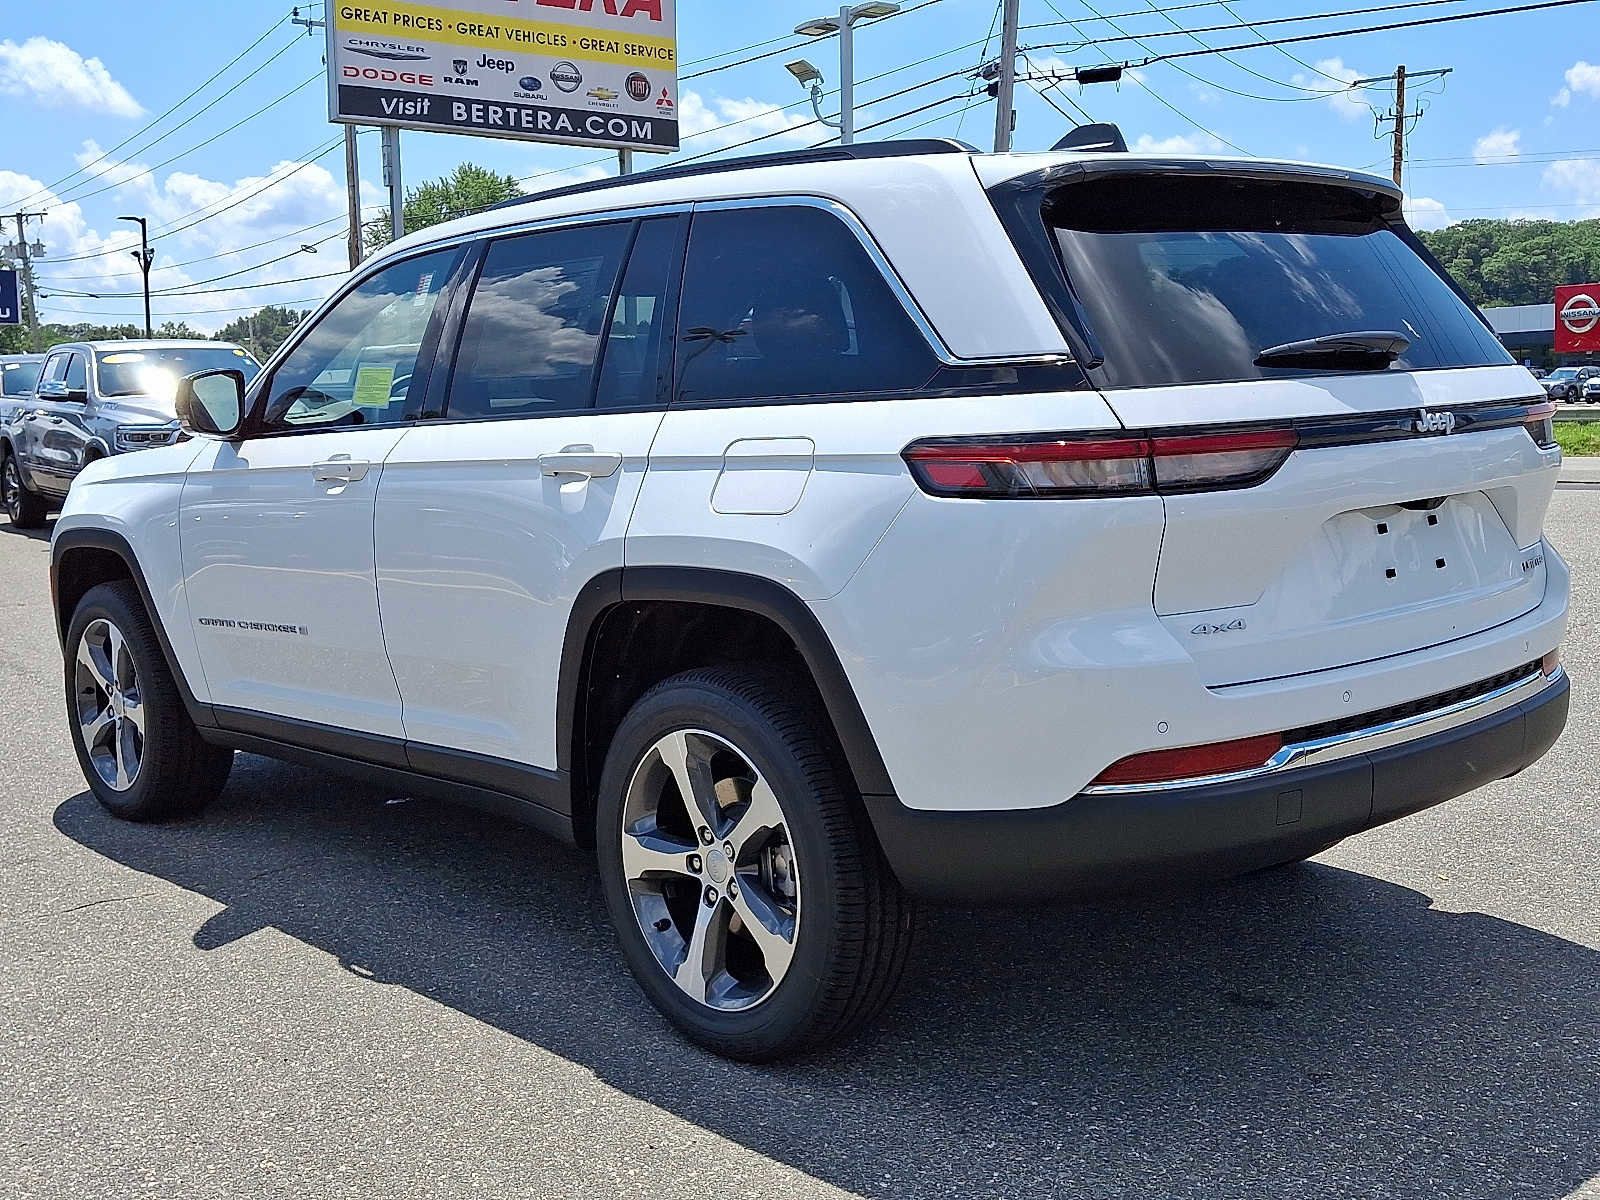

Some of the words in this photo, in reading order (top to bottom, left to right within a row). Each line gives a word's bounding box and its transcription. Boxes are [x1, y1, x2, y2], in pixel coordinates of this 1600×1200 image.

[341, 7, 388, 24] GREAT
[393, 12, 443, 31] PRICES
[456, 22, 500, 39] GREAT
[505, 28, 567, 47] VEHICLES
[579, 37, 620, 54] GREAT
[624, 43, 674, 61] SERVICE
[348, 39, 425, 53] CHRYSLER
[476, 53, 515, 74] Jeep
[343, 65, 434, 86] DODGE
[443, 76, 479, 87] RAM
[552, 72, 580, 82] NISSAN
[631, 80, 646, 95] FIAT
[513, 91, 548, 101] SUBARU
[587, 101, 619, 109] CHEVROLET
[381, 97, 431, 116] Visit
[452, 102, 652, 140] BERTERA.COM
[1561, 309, 1596, 319] NISSAN
[1415, 408, 1456, 435] Jeep
[199, 617, 236, 628] GRAND
[237, 620, 298, 634] CHEROKEE
